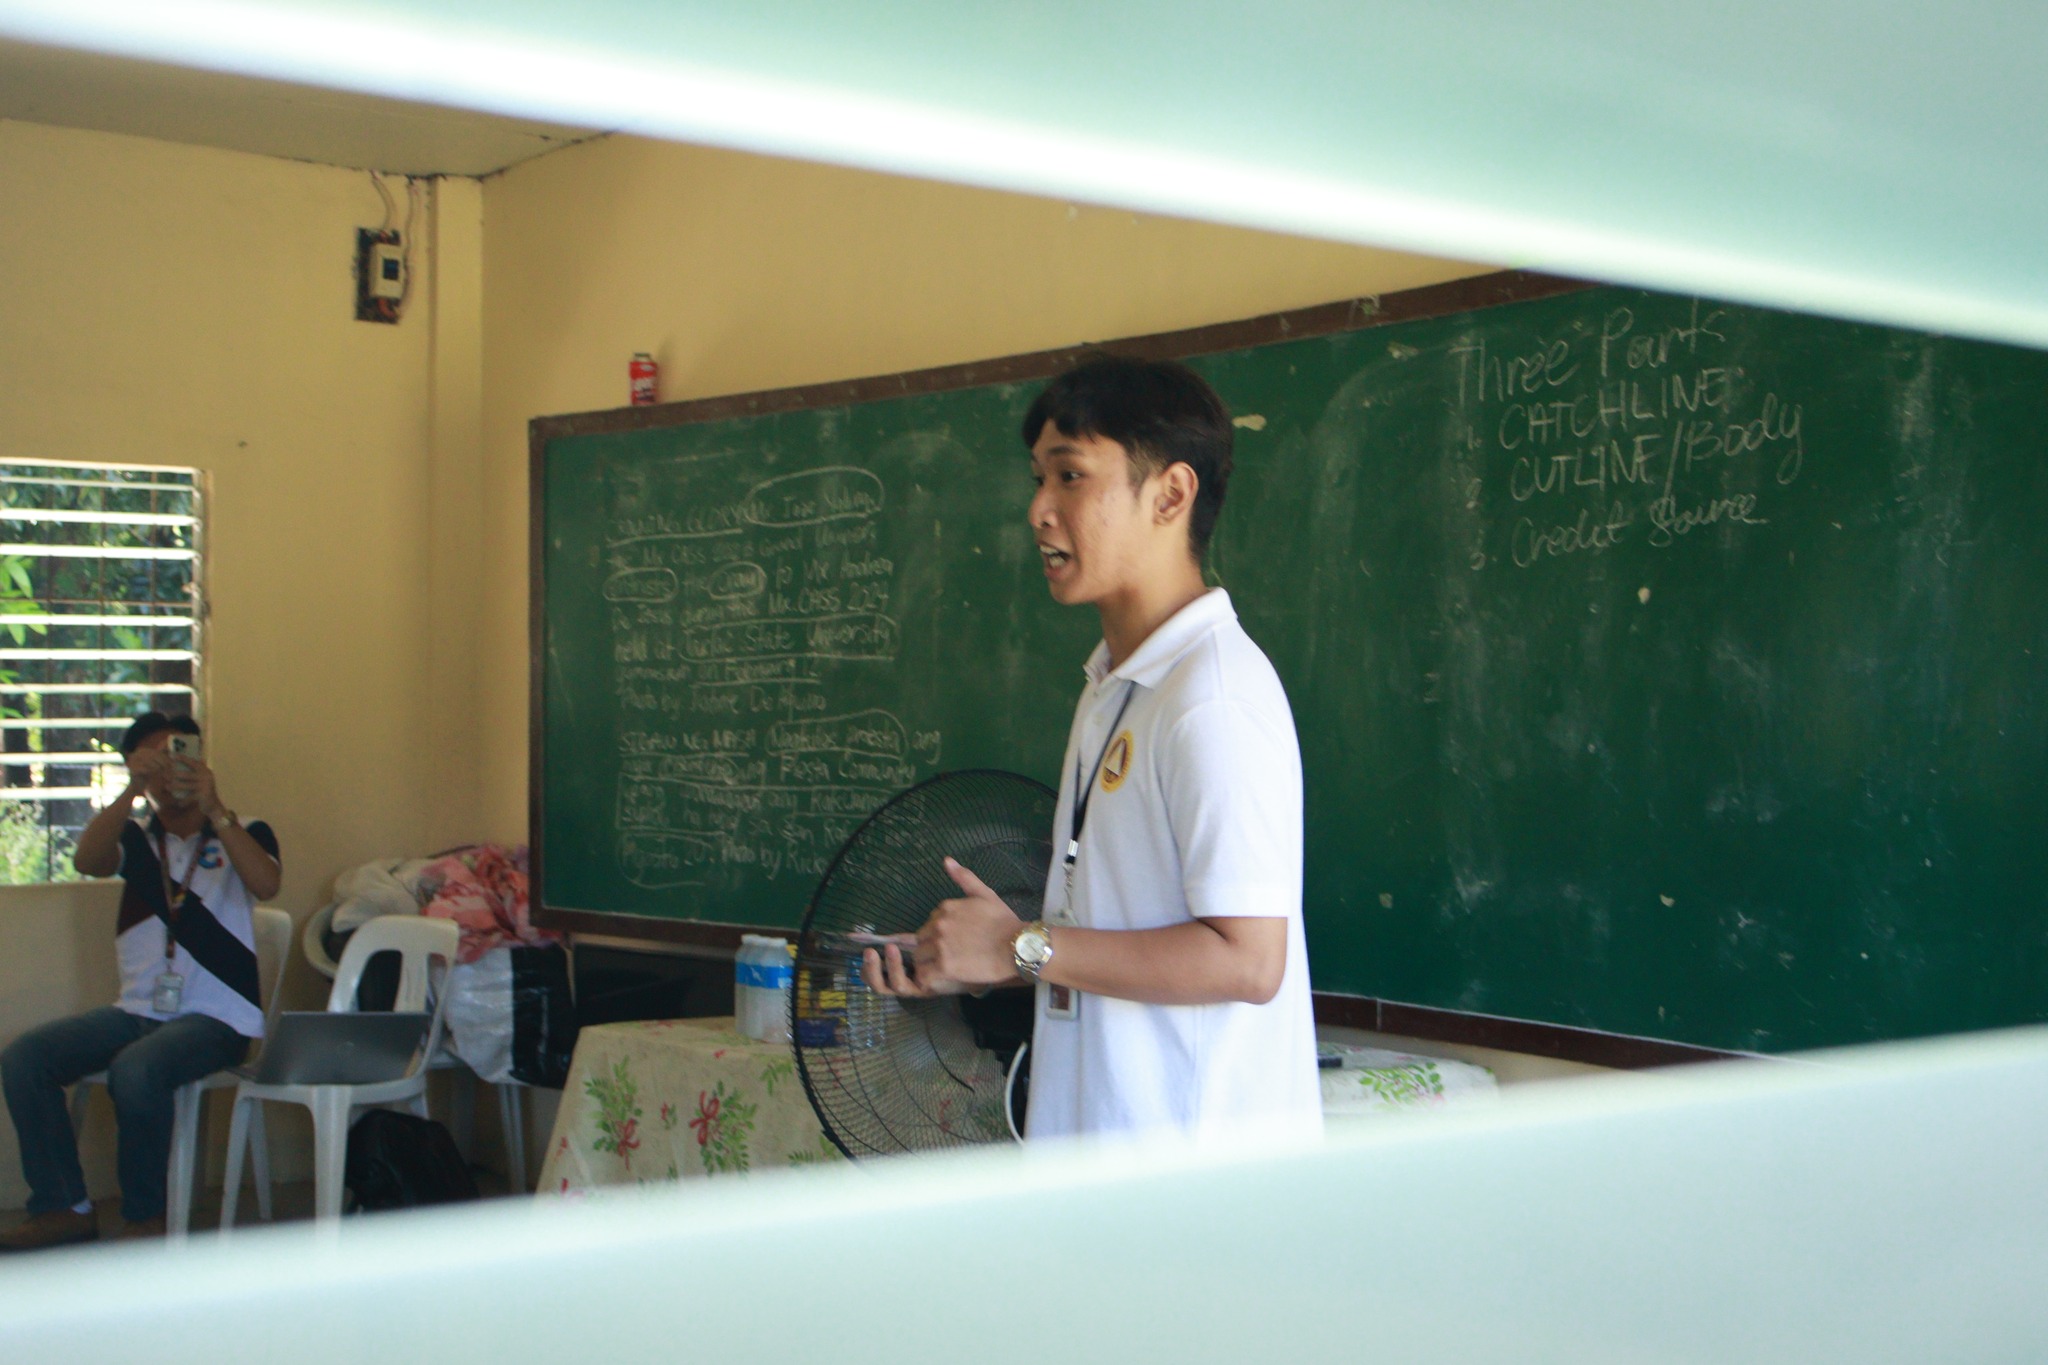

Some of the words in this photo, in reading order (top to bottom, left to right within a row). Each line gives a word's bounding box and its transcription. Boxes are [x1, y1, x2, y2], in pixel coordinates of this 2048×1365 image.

[1449, 337, 1581, 407] Three
[1600, 294, 1727, 377] Parts
[1500, 366, 1728, 450] CATCHLINE
[1510, 501, 1631, 568] Credit
